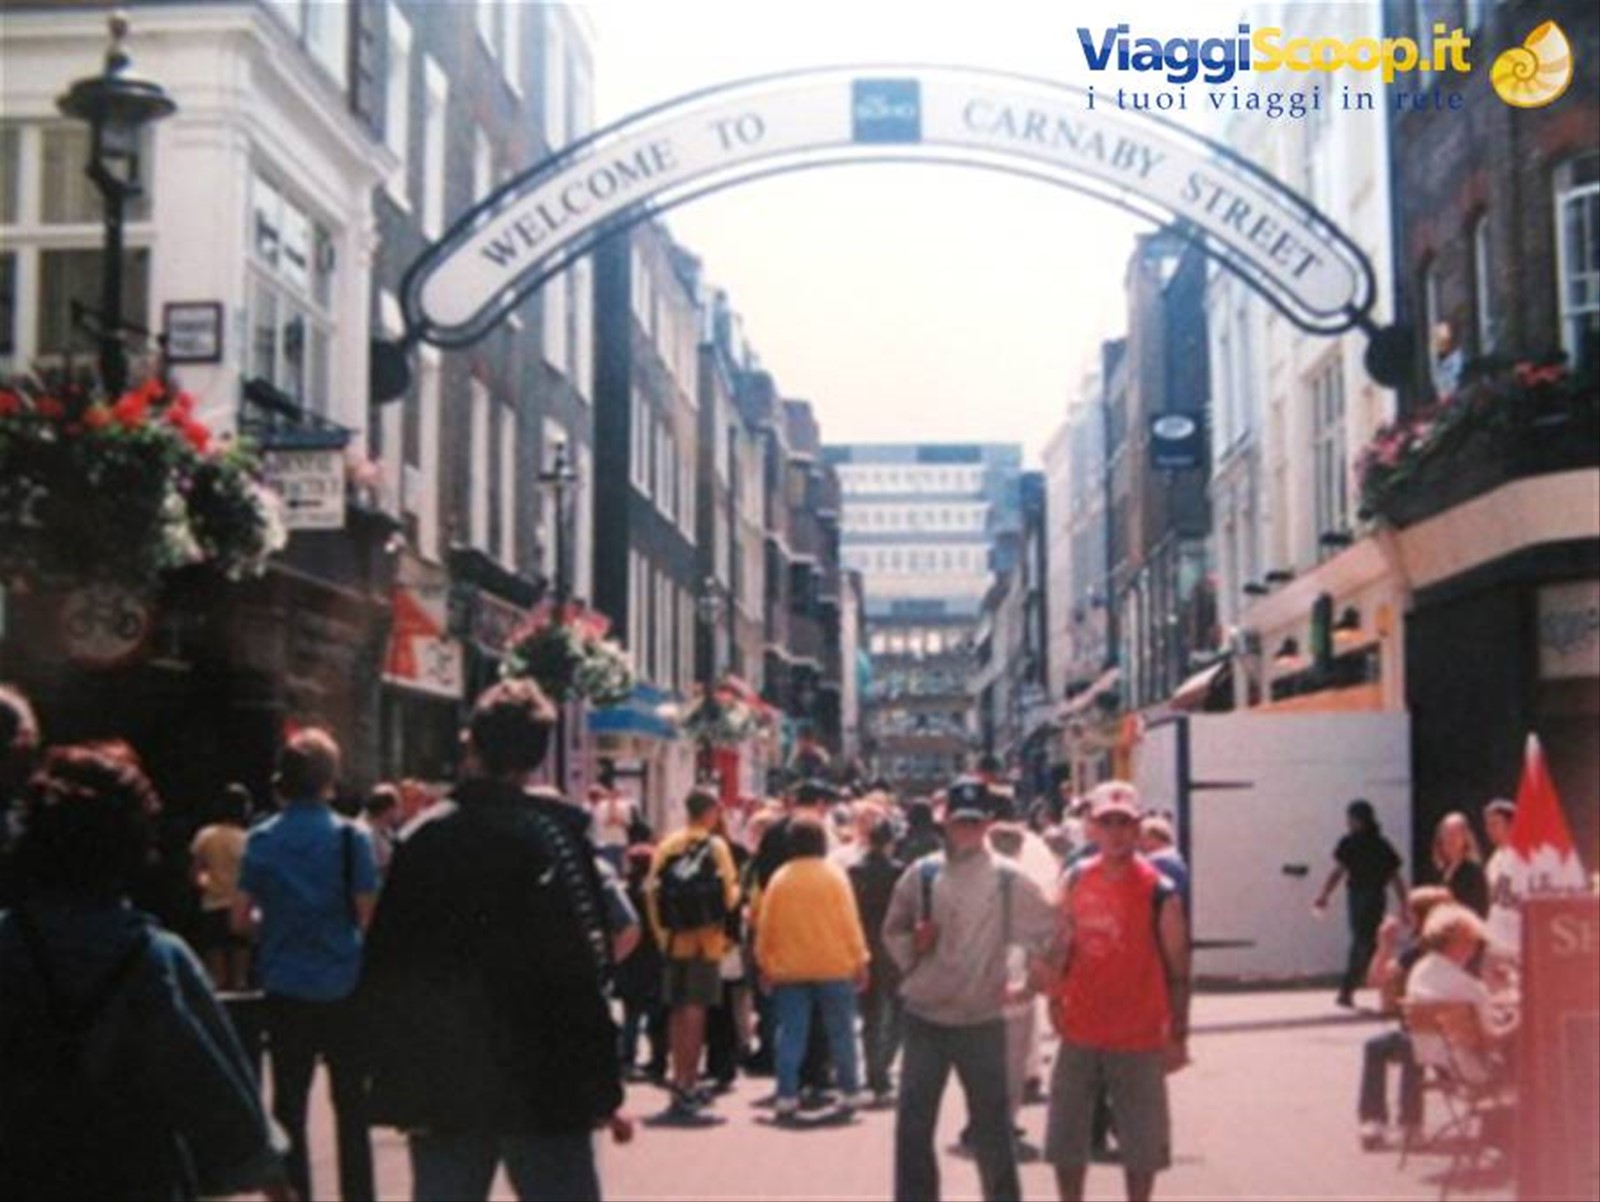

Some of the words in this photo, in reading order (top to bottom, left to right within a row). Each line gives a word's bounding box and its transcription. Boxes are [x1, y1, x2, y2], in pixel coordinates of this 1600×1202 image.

[480, 140, 678, 268] WELCOME
[709, 112, 766, 151] TO
[961, 98, 1166, 180] CARNABY
[1181, 172, 1323, 279] STREET
